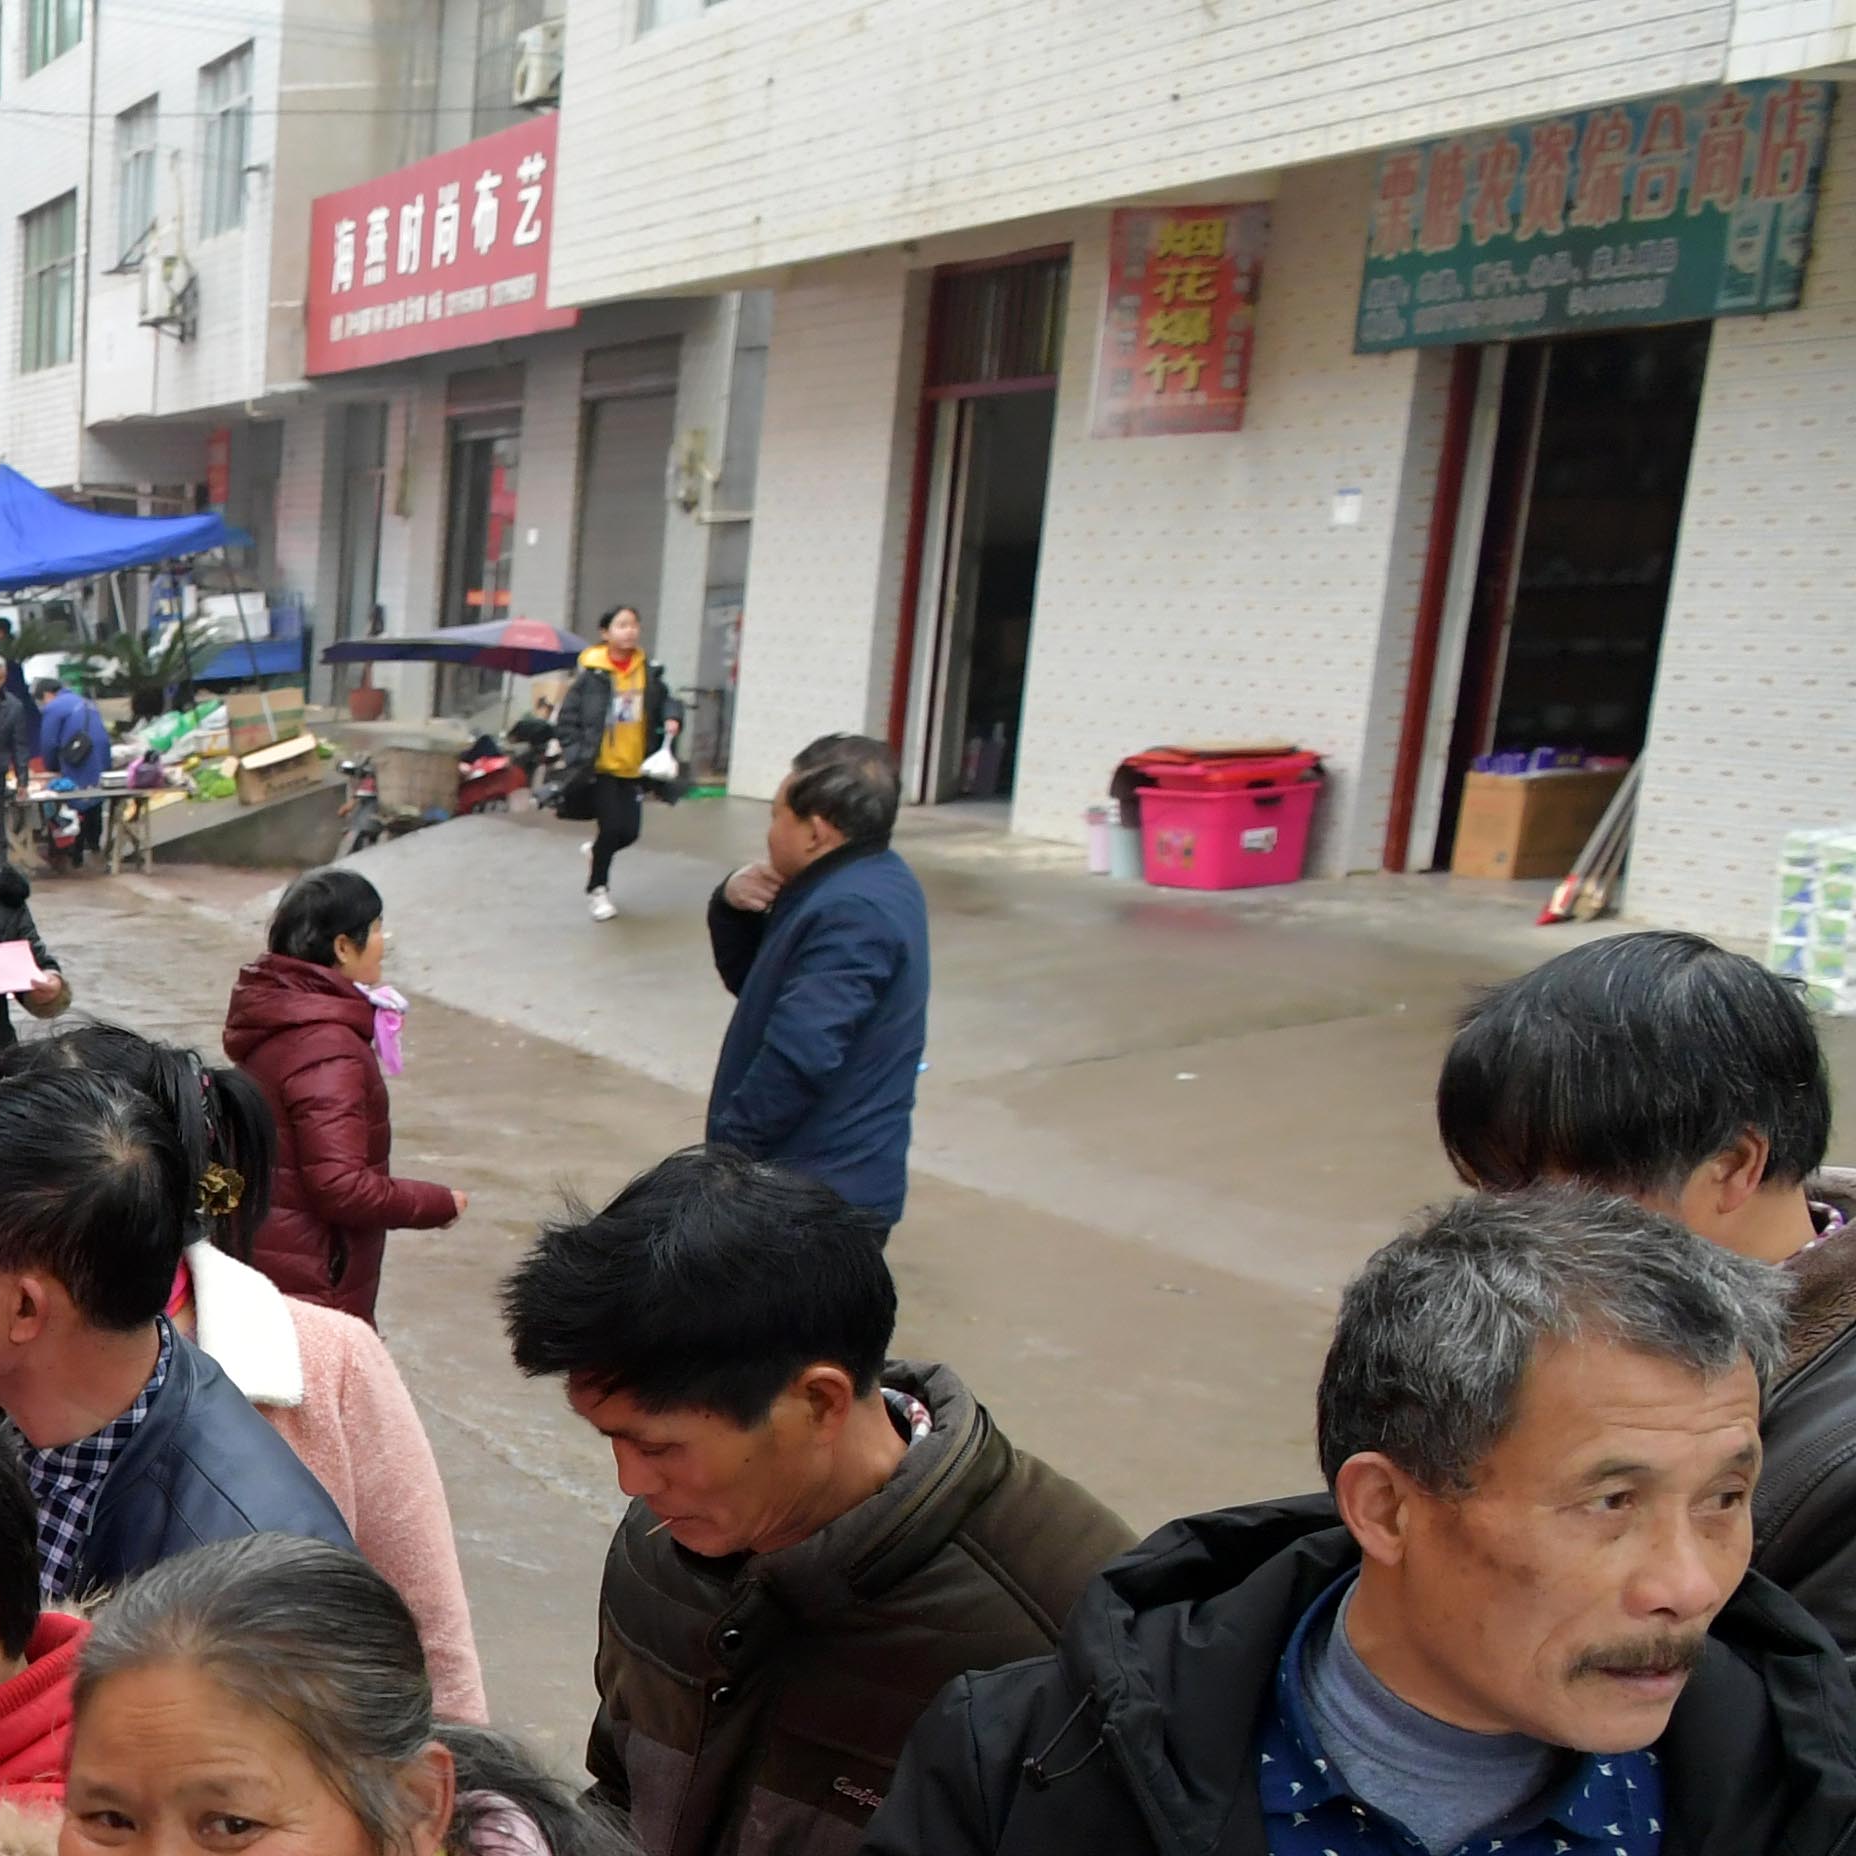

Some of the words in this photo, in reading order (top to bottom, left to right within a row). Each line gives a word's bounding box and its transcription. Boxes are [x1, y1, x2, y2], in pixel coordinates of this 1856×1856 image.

[330, 151, 548, 295] 海燕时尚布艺
[1145, 217, 1228, 394] 烟花爆竹
